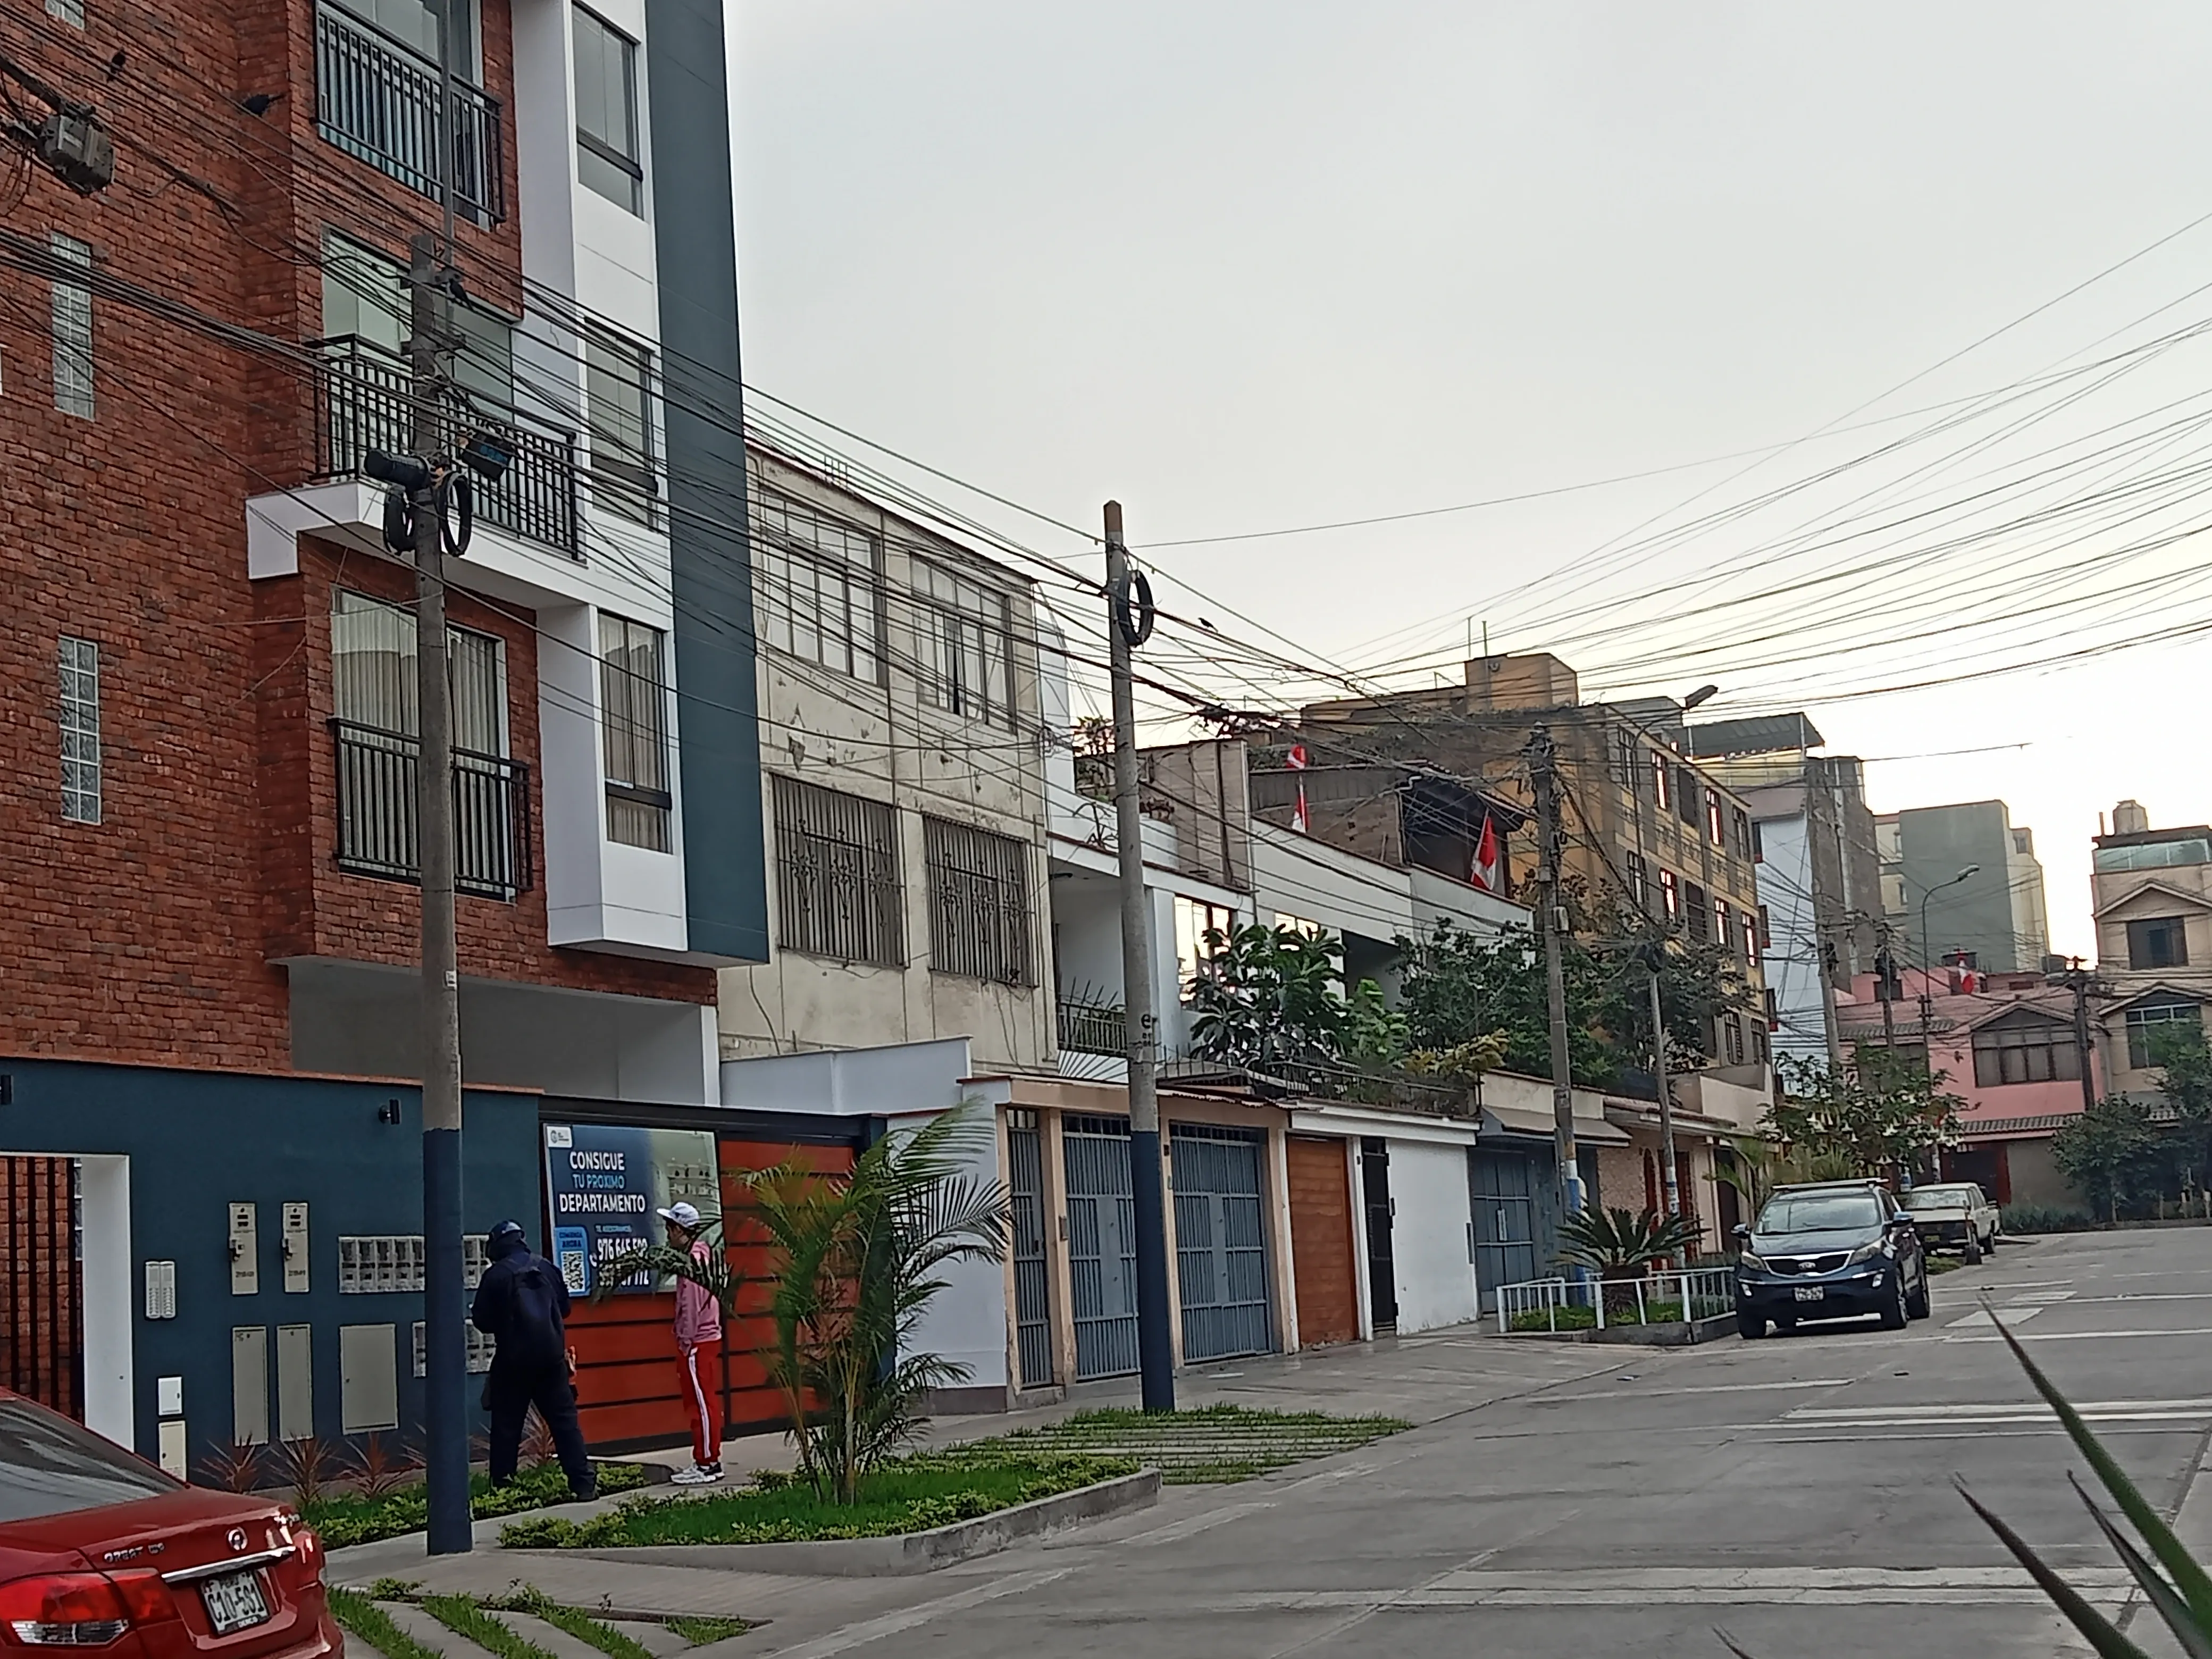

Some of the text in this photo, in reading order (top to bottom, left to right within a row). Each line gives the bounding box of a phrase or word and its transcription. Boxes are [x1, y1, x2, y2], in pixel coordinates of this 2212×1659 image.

[569, 1151, 625, 1170] CONSIGUE
[572, 1174, 584, 1188] TU
[559, 1194, 646, 1212] DEPARTAMENTO
[598, 1238, 614, 1261] 976
